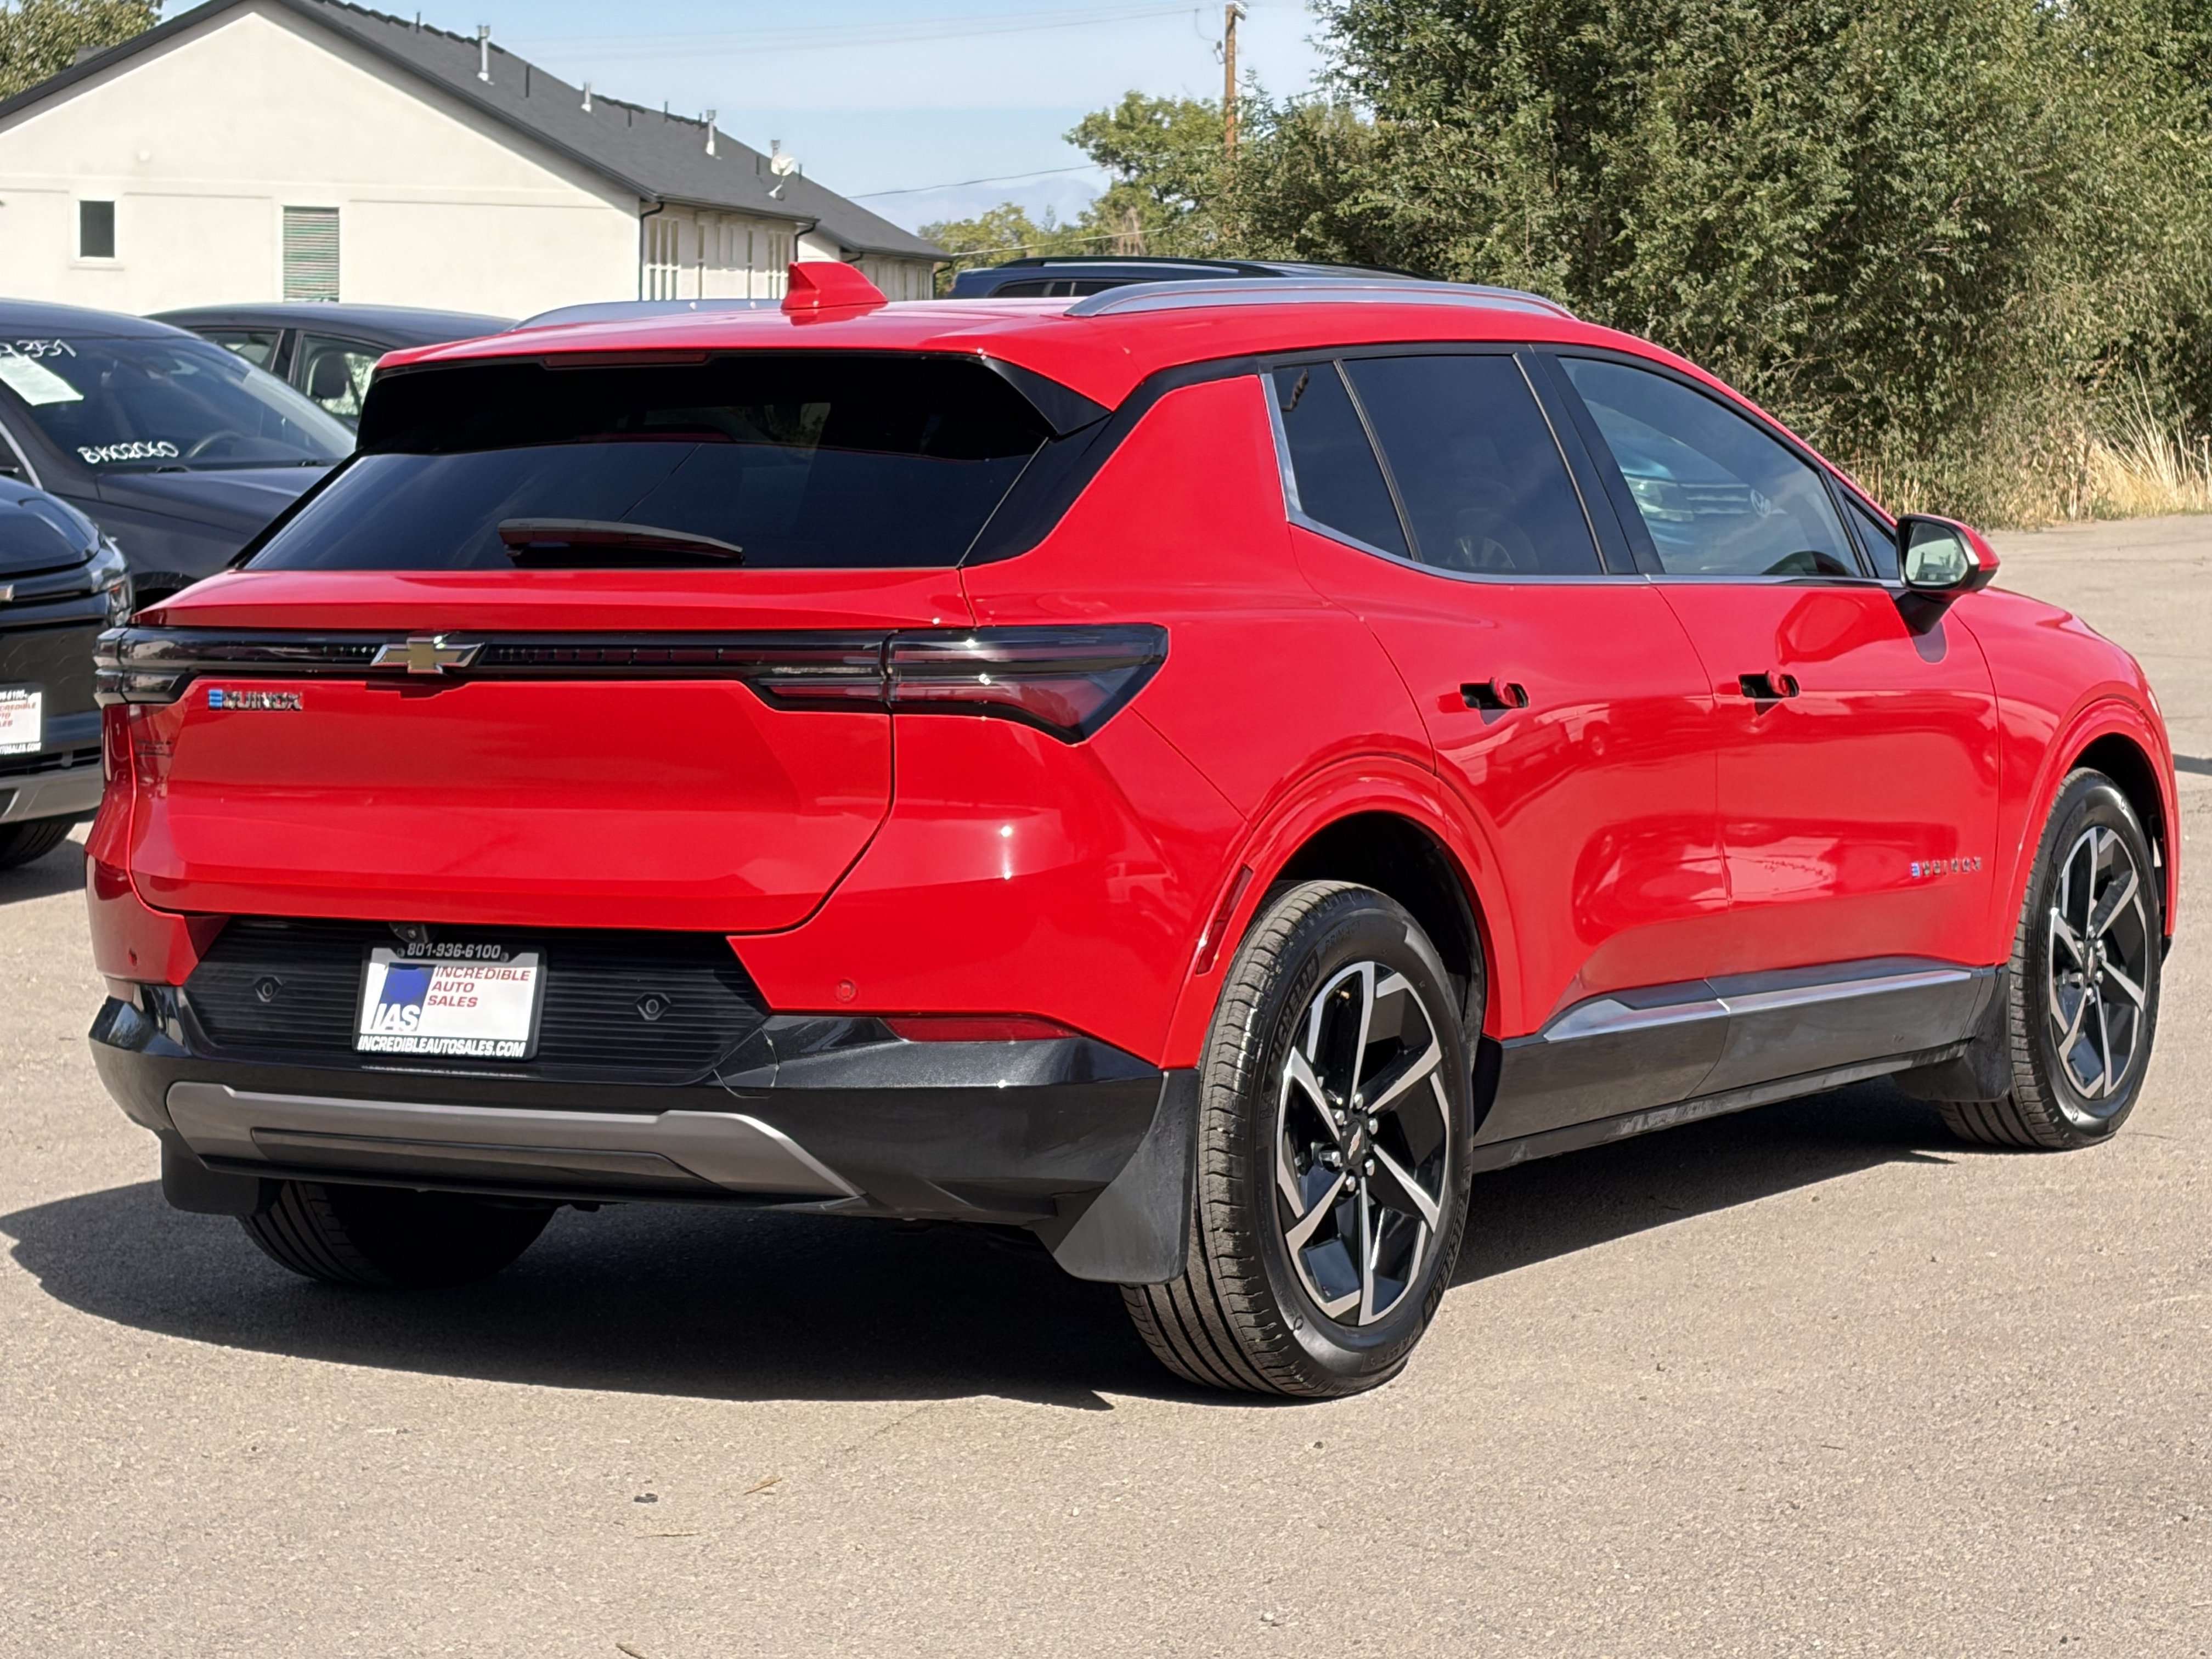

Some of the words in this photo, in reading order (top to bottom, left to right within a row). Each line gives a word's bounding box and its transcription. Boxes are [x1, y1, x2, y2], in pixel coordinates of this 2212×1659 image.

[435, 966, 531, 982] INCREDIBLE
[431, 981, 475, 994] AUTO
[427, 995, 478, 1008] SALES
[373, 1003, 421, 1031] IAS
[357, 1035, 526, 1058] INCREDIBLEAUTOSALES.COM
